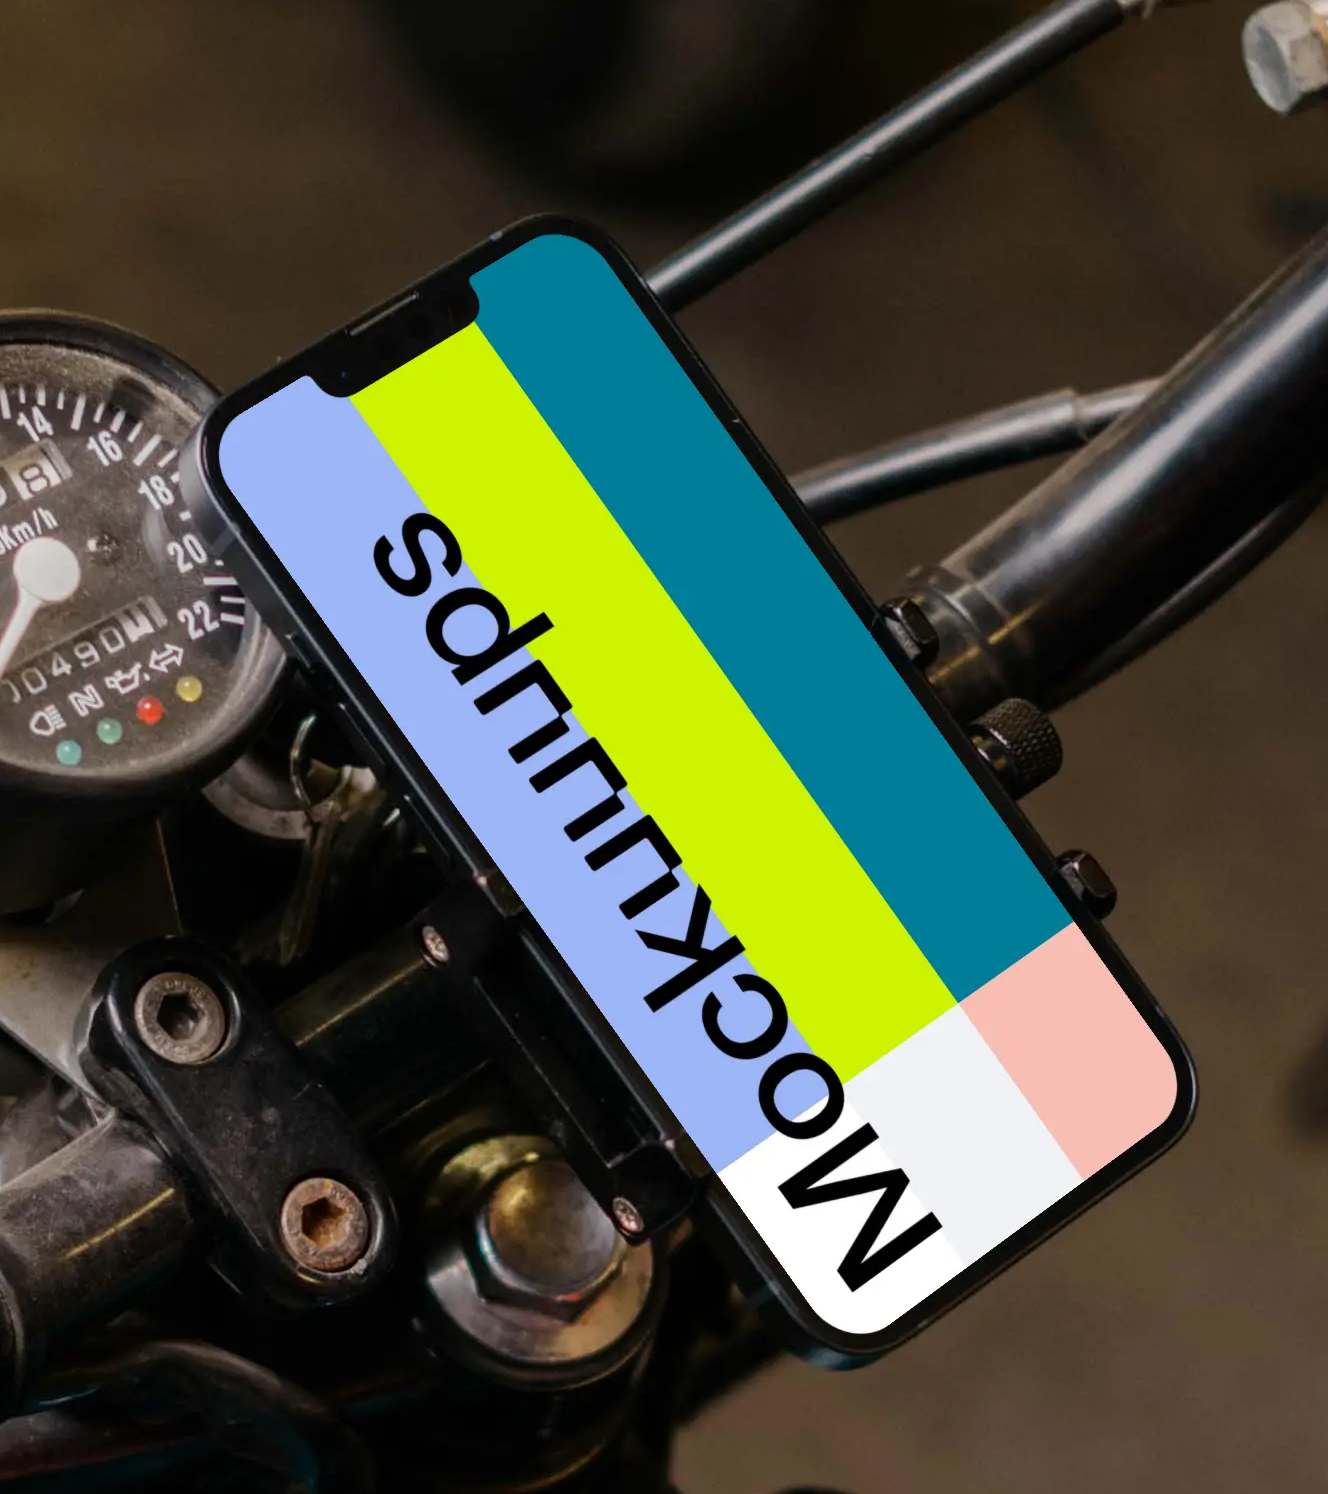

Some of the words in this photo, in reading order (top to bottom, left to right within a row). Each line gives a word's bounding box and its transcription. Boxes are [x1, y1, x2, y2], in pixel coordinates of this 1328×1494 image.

[16, 406, 54, 442] 14
[86, 430, 123, 466] 16
[138, 474, 174, 510] 18
[167, 533, 207, 573] 20
[177, 600, 220, 640] 22
[68, 684, 104, 717] N
[373, 512, 944, 1293] Mockuuups
